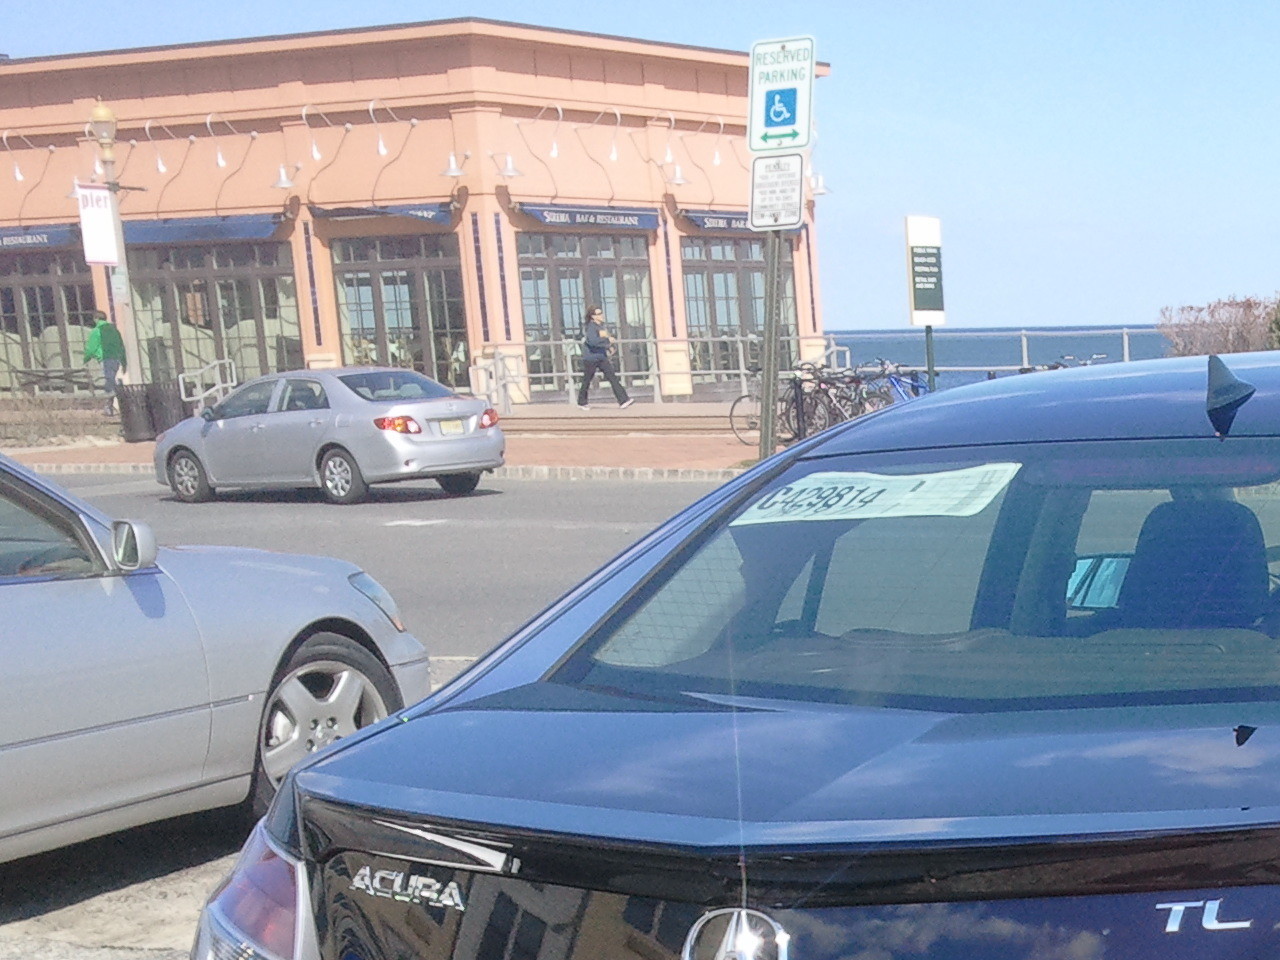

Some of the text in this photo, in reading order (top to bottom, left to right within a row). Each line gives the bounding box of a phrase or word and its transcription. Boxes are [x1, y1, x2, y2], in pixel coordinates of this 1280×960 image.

[756, 48, 809, 66] RESERVED
[759, 67, 806, 84] PARKING
[349, 866, 466, 912] ACURA
[1155, 898, 1253, 933] TL
